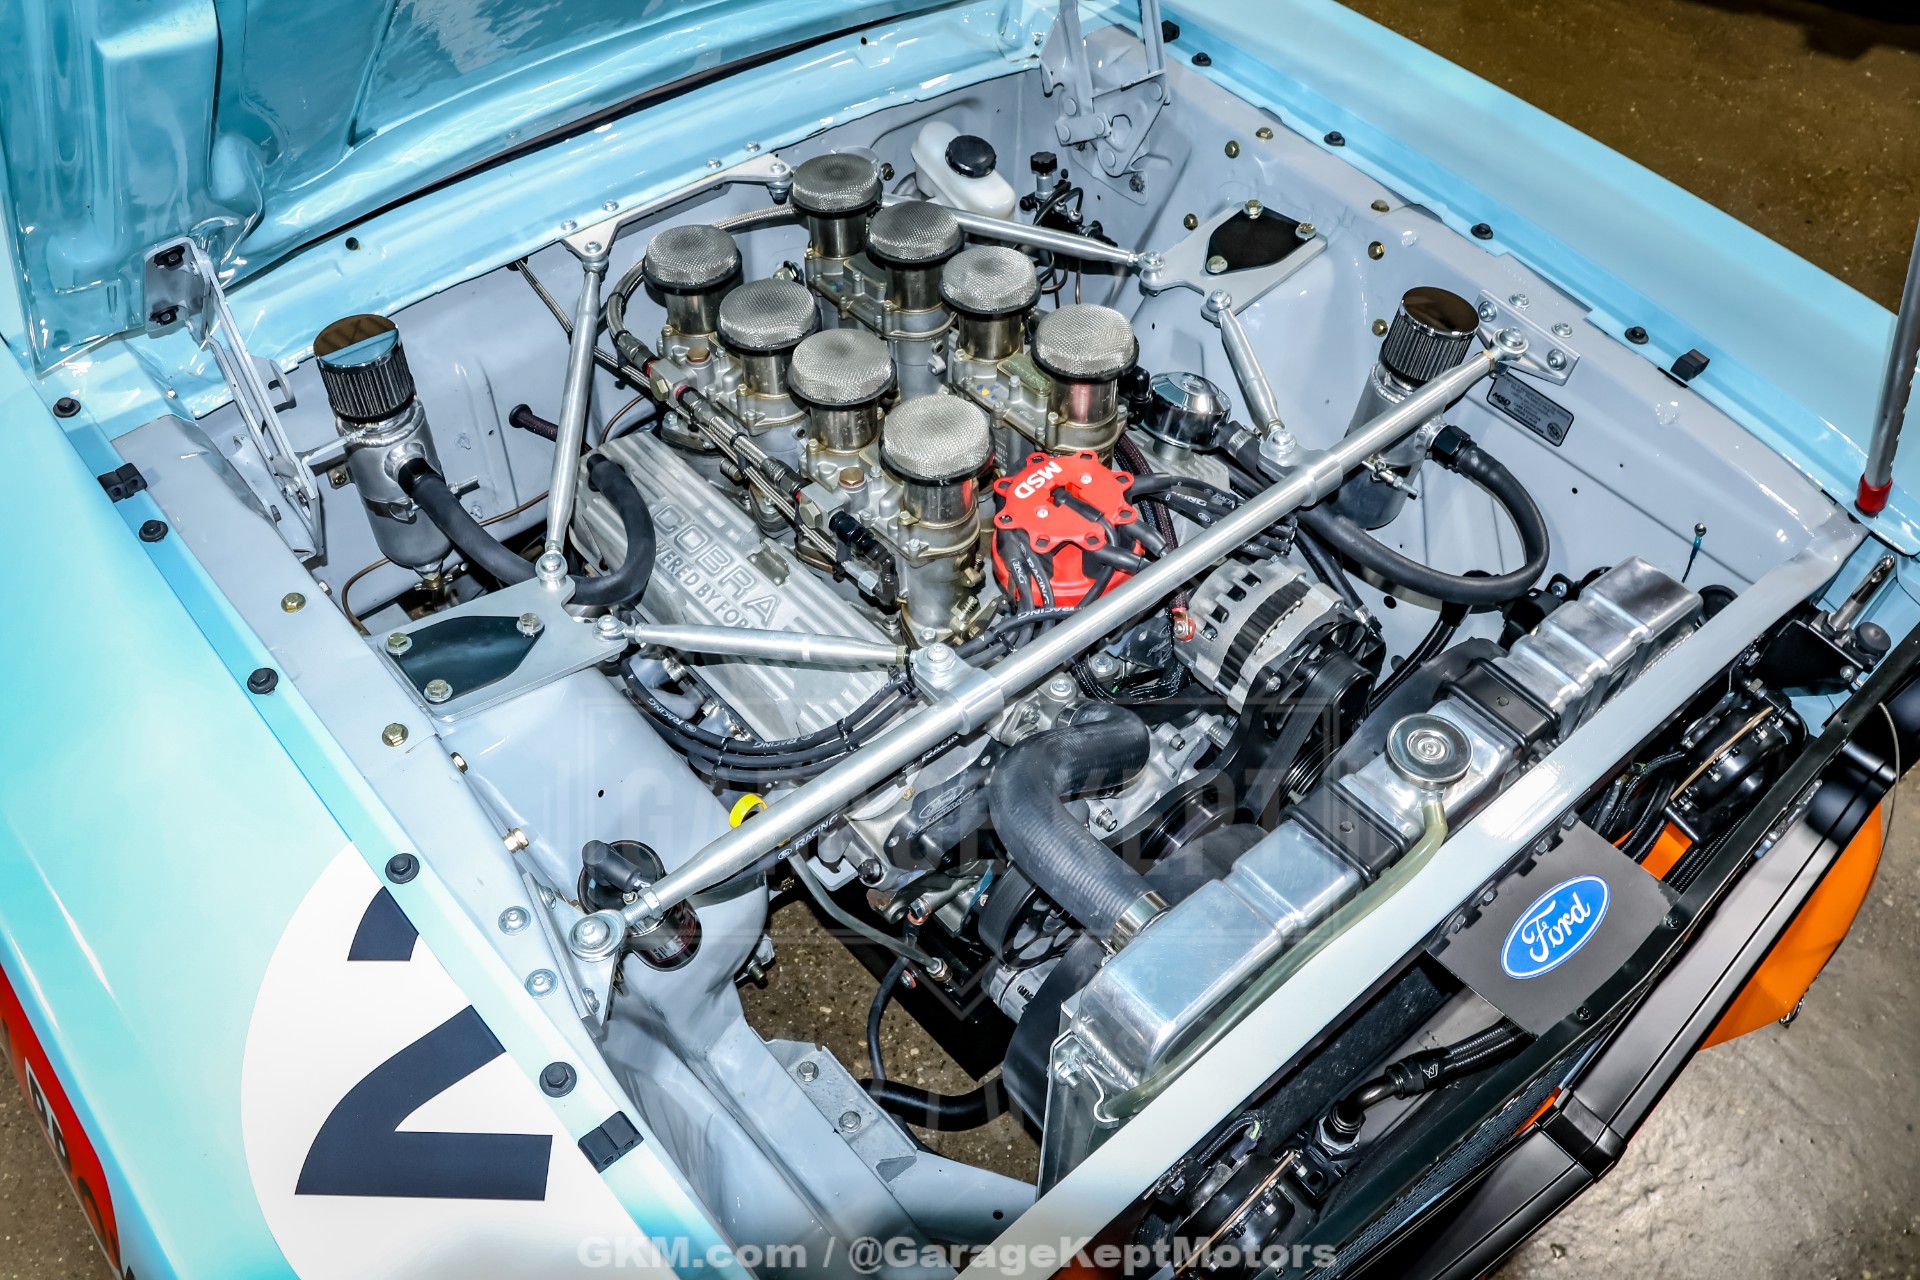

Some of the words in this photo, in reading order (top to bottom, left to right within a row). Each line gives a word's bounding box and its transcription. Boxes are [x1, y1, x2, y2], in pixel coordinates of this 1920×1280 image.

[1014, 461, 1063, 499] MSD
[652, 503, 781, 628] COBRA
[1026, 556, 1050, 606] RACING
[694, 583, 722, 605] BY
[713, 602, 759, 629] FOR
[1017, 606, 1076, 620] RACING
[647, 697, 685, 726] RACING
[752, 737, 799, 749] RACING
[794, 813, 839, 851] RACING
[1521, 891, 1591, 963] Ford
